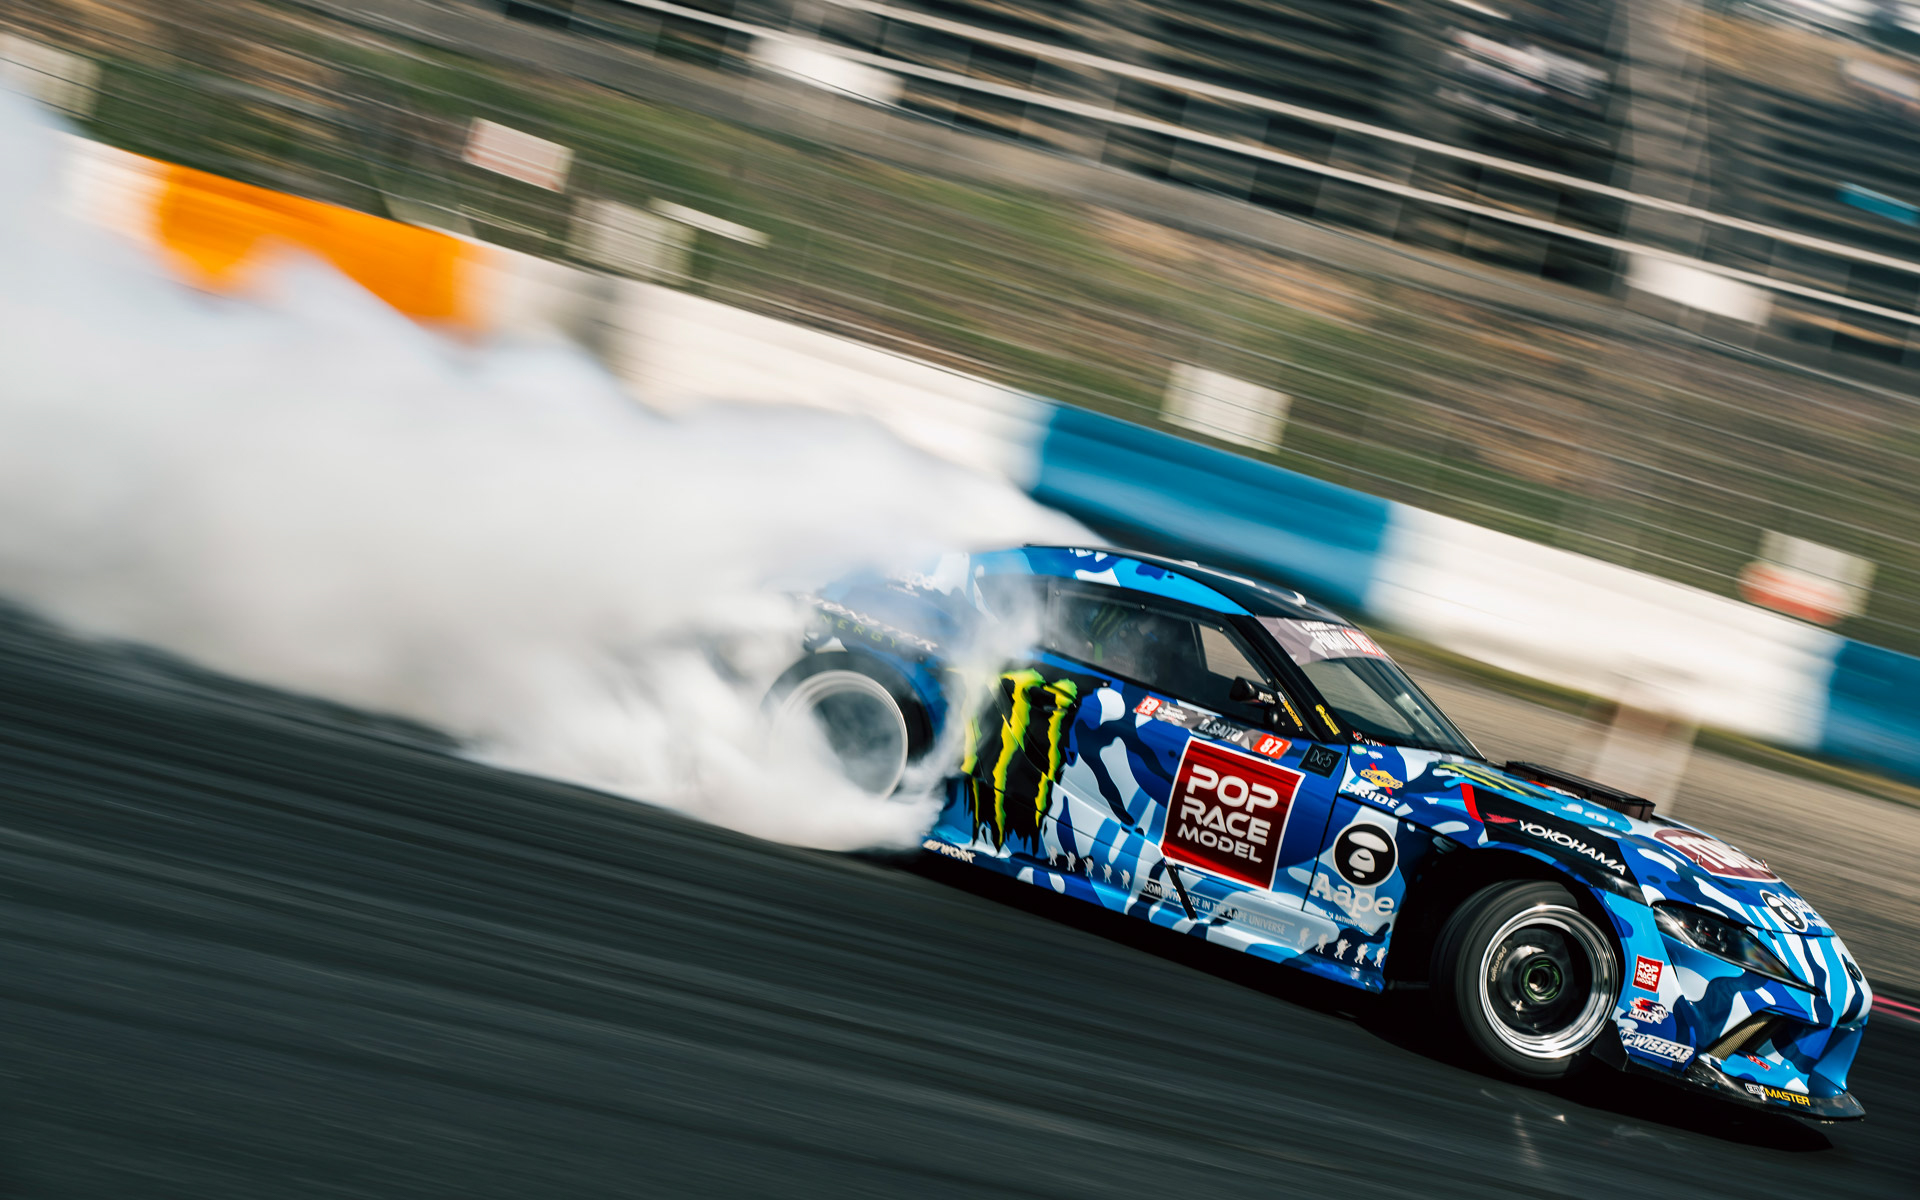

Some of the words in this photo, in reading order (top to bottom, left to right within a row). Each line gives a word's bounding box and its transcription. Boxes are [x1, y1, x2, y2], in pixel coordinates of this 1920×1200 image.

[1259, 737, 1284, 756] 87
[1186, 763, 1279, 813] POP
[1180, 795, 1272, 846] RACE
[940, 843, 976, 864] WORK
[1177, 823, 1263, 864] MODEL
[1518, 819, 1627, 876] YOKOHAMA
[1309, 872, 1395, 919] Aape
[1201, 900, 1211, 910] IN
[1248, 914, 1286, 935] UNIVERSE
[1637, 969, 1658, 982] RACE
[1638, 960, 1660, 974] POP
[1632, 1035, 1694, 1061] WISEFAB
[1764, 1087, 1811, 1107] MASTER
